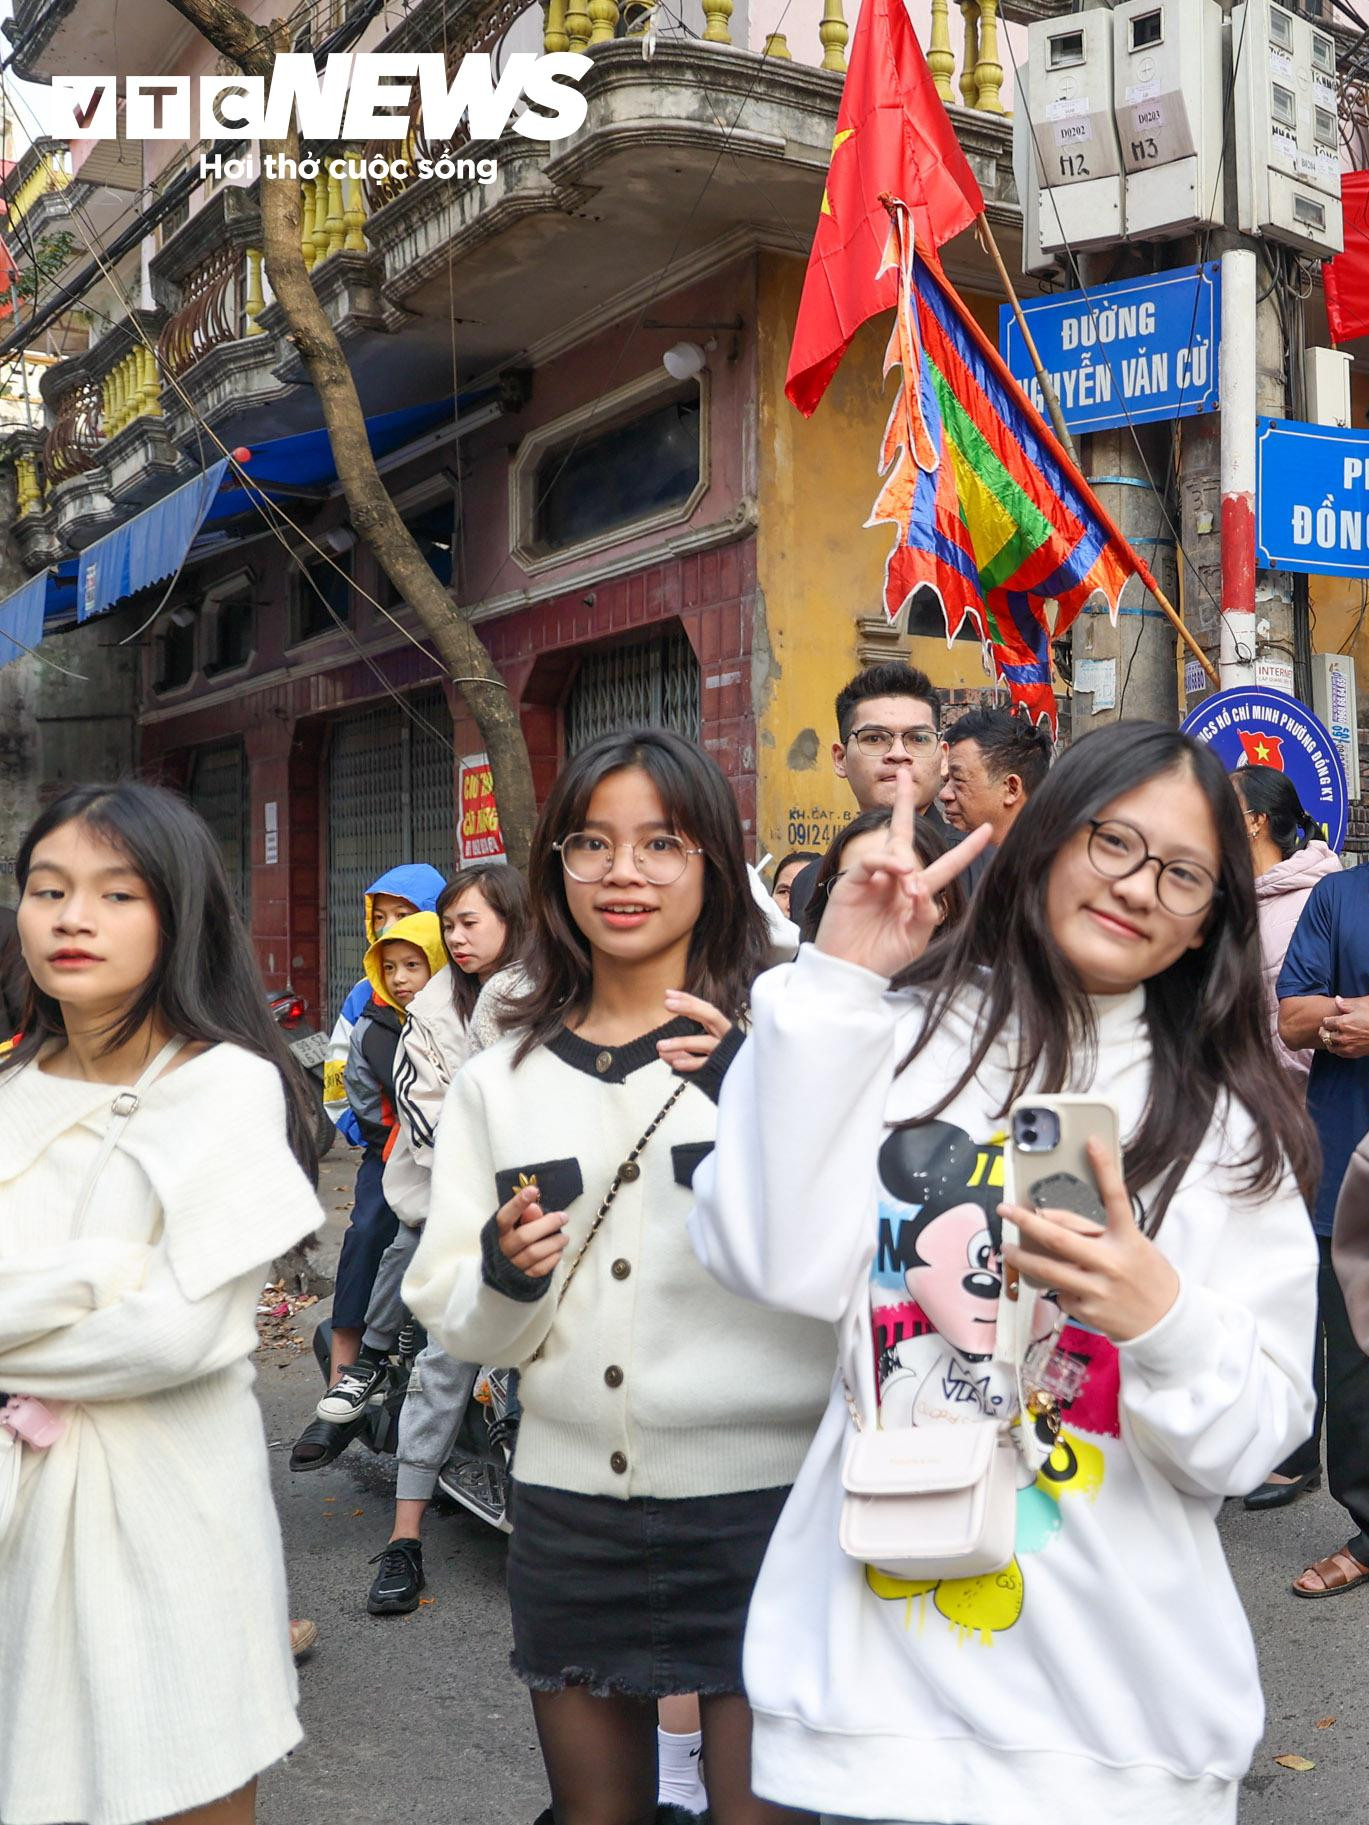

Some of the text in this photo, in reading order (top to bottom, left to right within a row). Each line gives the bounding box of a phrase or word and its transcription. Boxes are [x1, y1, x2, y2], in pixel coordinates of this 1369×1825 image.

[1060, 300, 1156, 351] ĐƯỜNG
[1121, 346, 1169, 399] VĂN
[1176, 333, 1210, 390] CỪ
[1217, 707, 1232, 730] HỒ
[1231, 702, 1251, 723] CHÍ
[1252, 705, 1280, 725] MINH
[1279, 713, 1318, 755] PHƯỜNG
[1311, 750, 1332, 786] ĐỒNG
